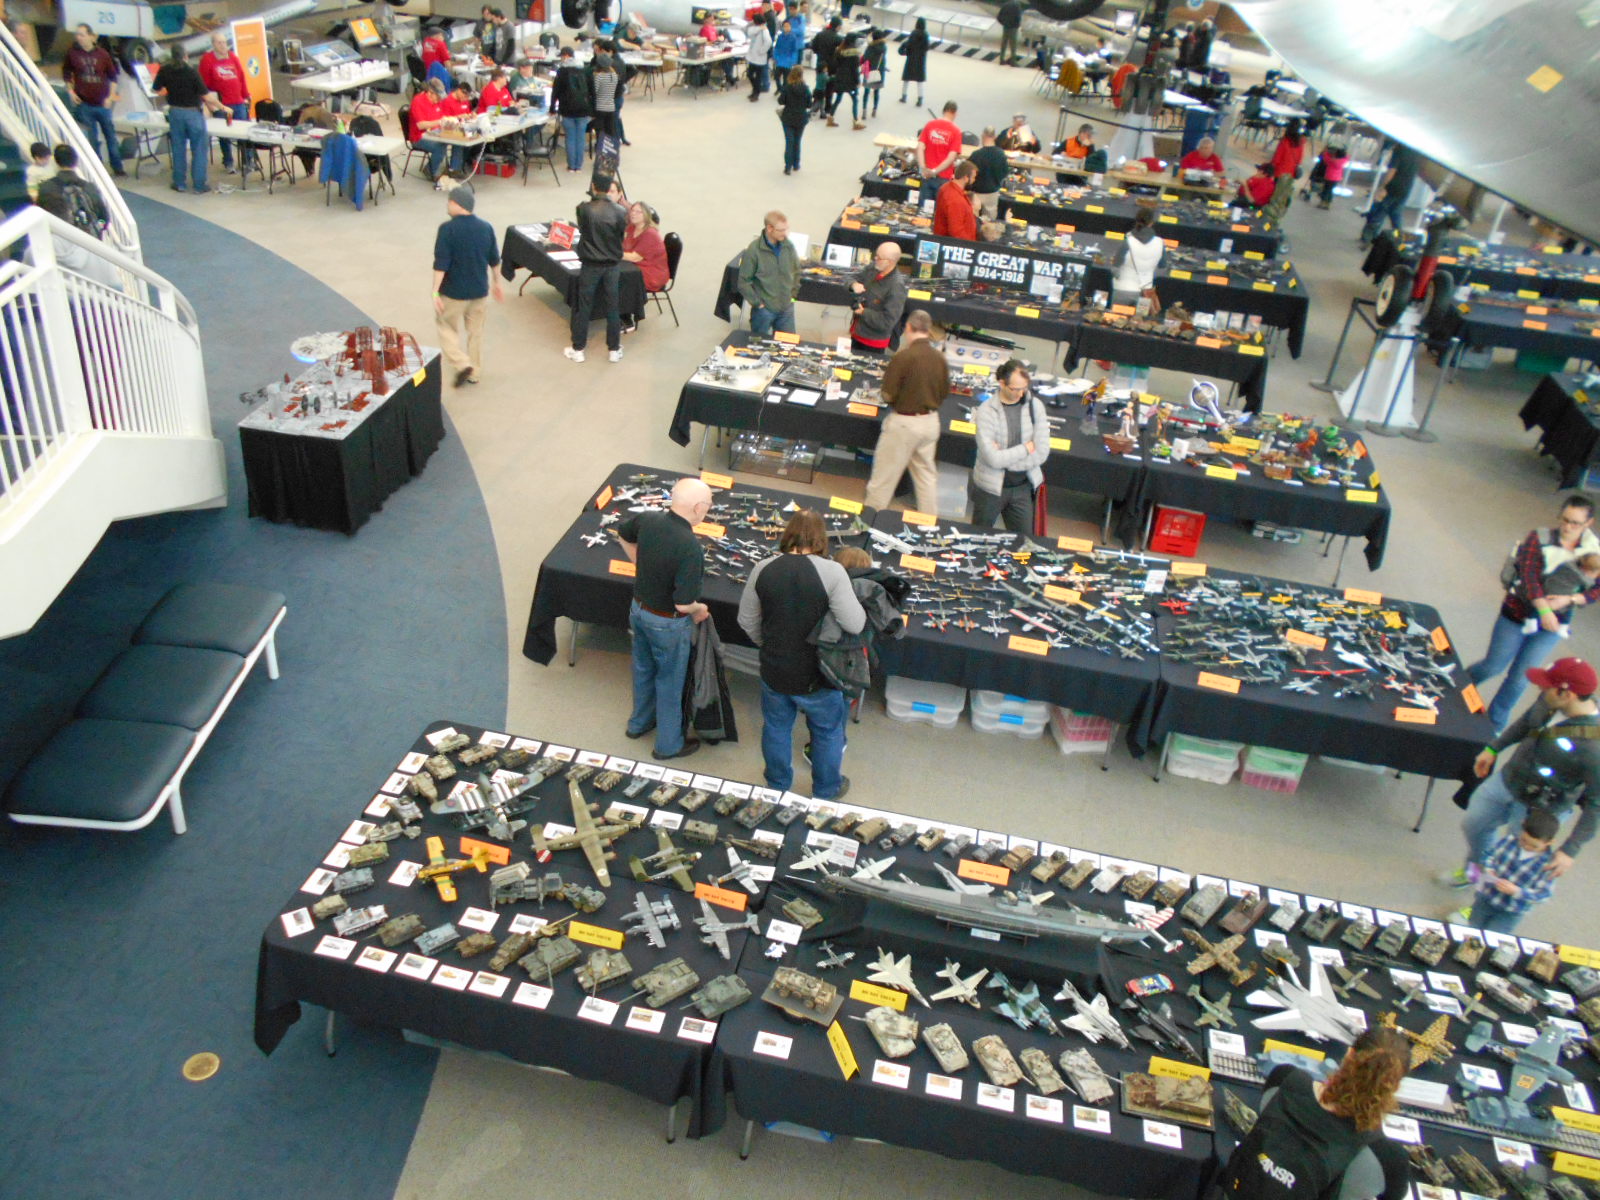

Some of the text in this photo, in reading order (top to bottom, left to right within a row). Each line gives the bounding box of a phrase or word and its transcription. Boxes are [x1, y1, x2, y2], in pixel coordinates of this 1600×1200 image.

[942, 245, 1063, 278] THE GREAT WAR
[972, 266, 1025, 284] 1914-1918
[1257, 1153, 1296, 1189] ANSR
